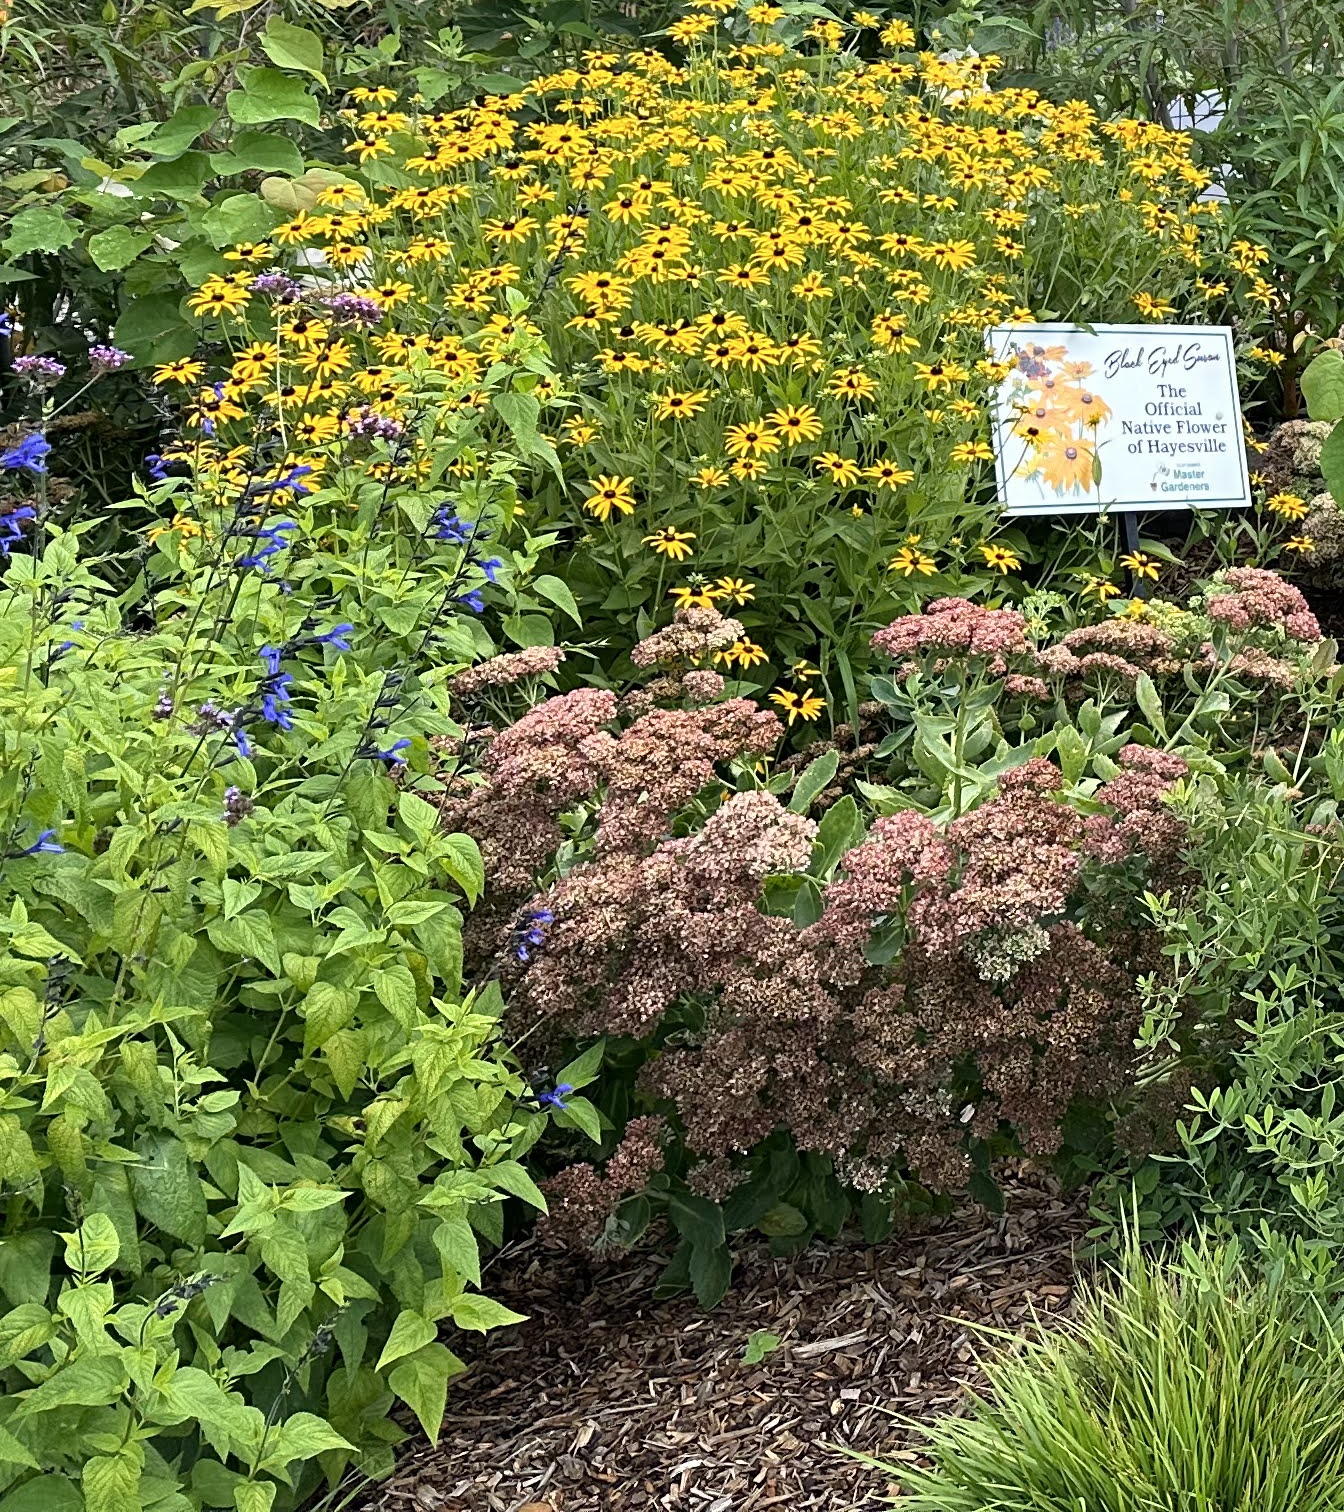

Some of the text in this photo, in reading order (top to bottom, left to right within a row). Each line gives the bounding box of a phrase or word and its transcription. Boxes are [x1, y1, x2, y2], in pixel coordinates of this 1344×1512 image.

[1157, 384, 1186, 398] The
[1145, 402, 1202, 416] Official
[1122, 420, 1227, 434] Native Flower
[1128, 439, 1226, 456] of Hayesville
[1174, 470, 1204, 479] Master
[1161, 482, 1209, 491] Gardeners
